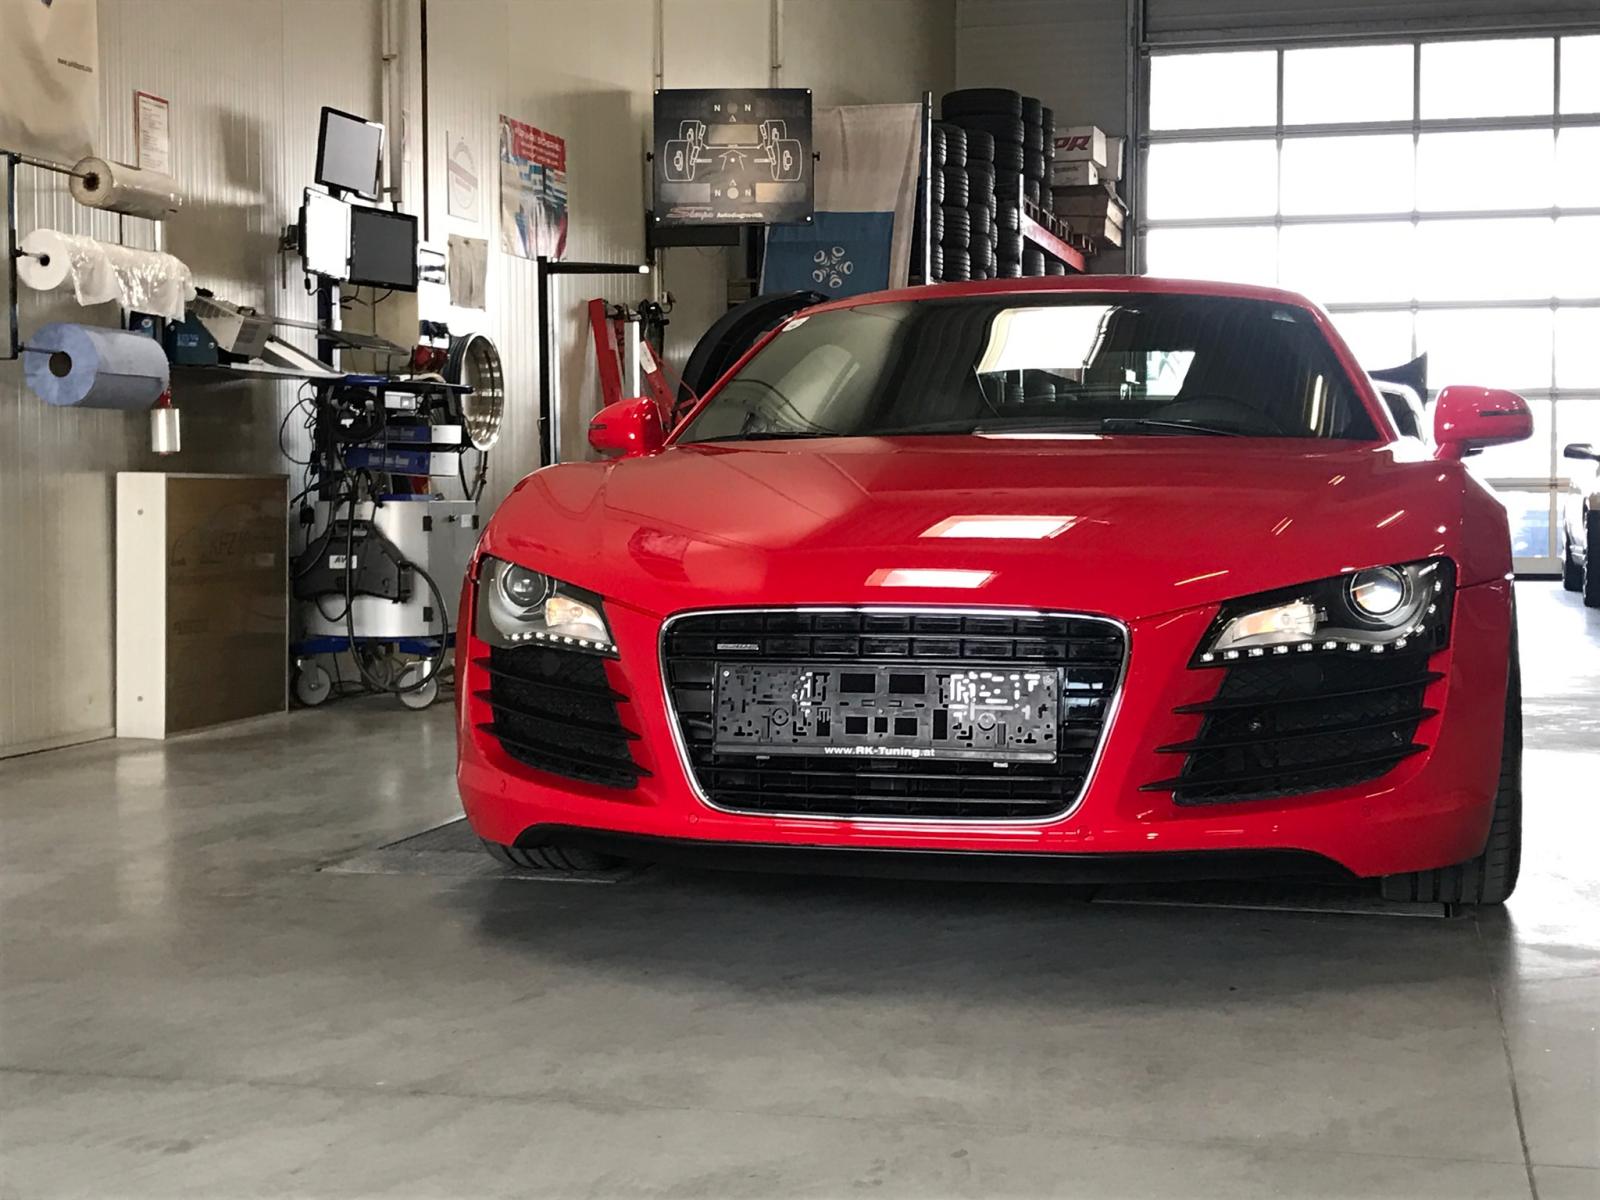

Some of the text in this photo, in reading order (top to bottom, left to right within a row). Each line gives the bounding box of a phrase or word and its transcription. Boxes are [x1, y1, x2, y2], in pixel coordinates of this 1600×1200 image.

[714, 104, 752, 112] N N
[714, 189, 752, 197] N N
[824, 746, 935, 758] www.RK-Tuning.at
